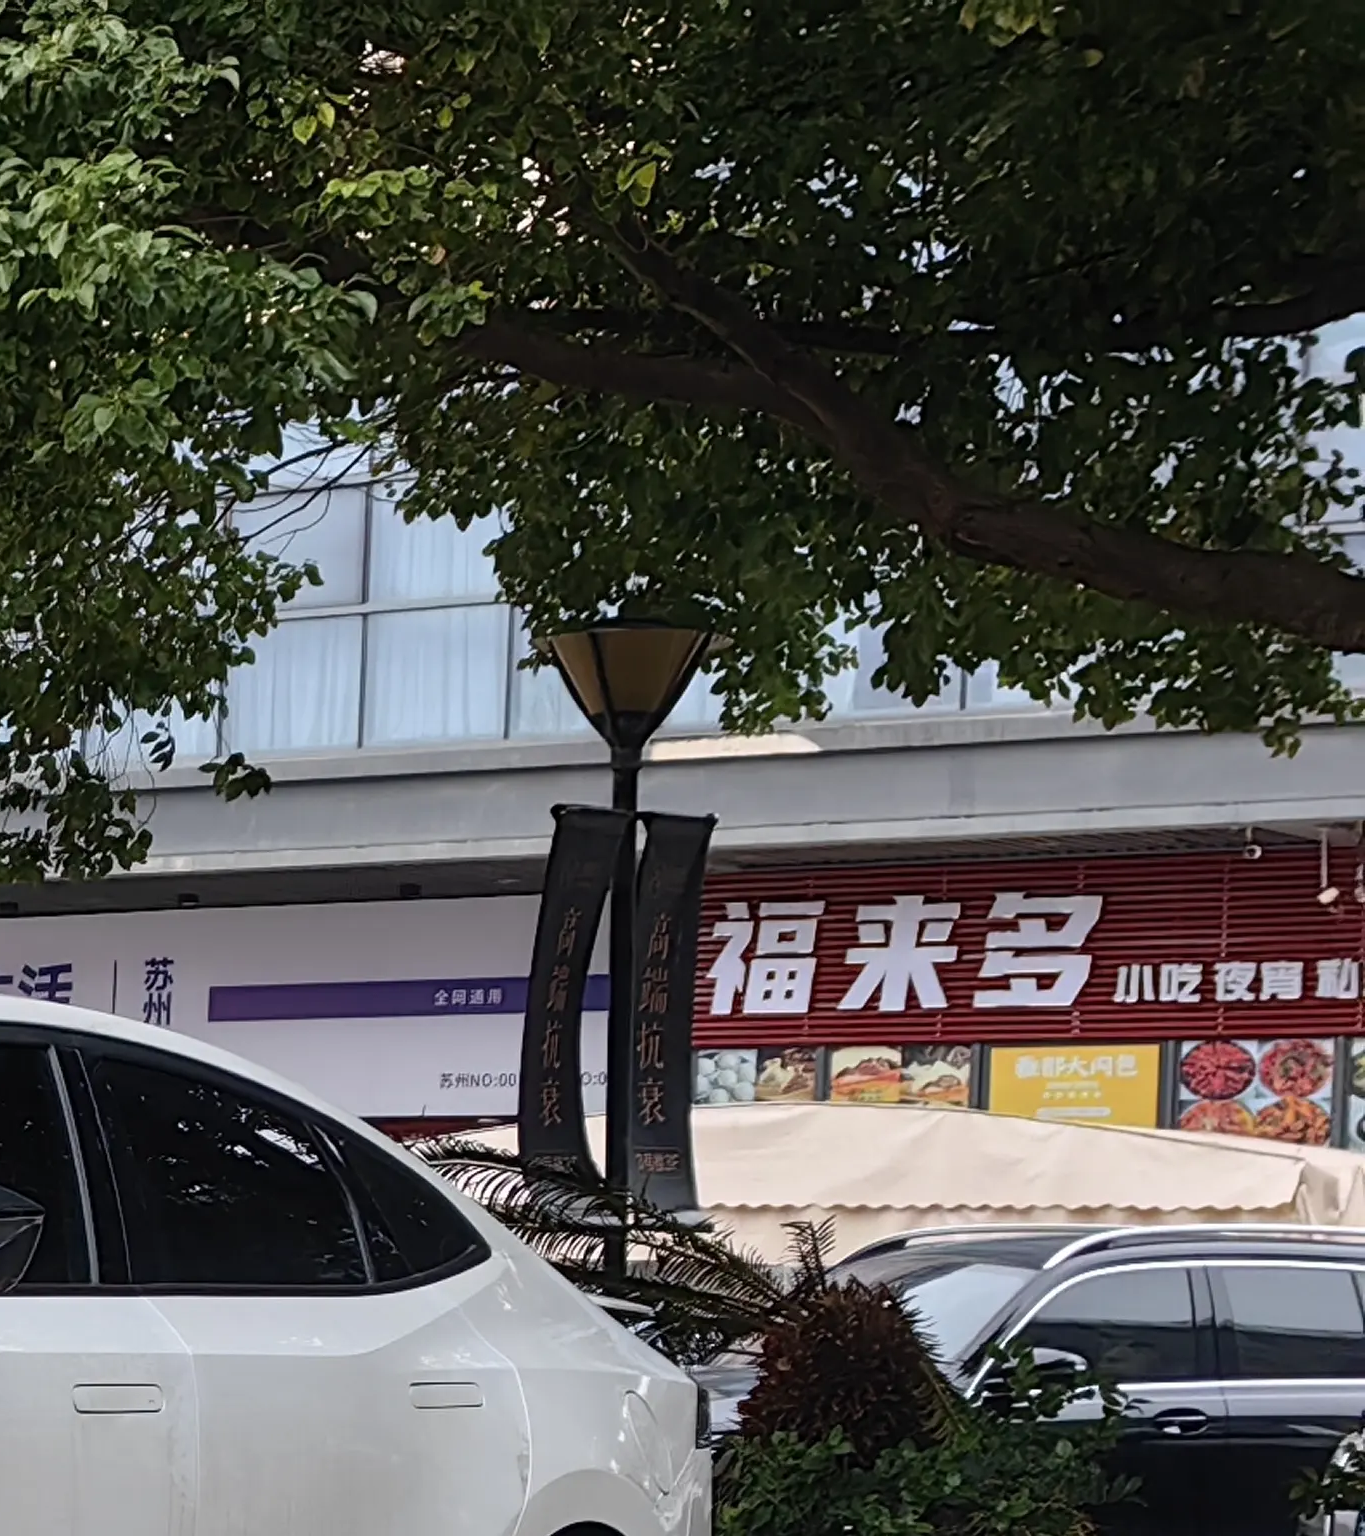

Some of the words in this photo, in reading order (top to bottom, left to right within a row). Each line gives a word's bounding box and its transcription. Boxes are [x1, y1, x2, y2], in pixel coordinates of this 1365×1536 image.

[142, 957, 175, 1026] 苏州
[706, 892, 1104, 1016] 福来多
[1113, 962, 1204, 1003] 小吃
[1214, 960, 1305, 1002] 夜宵
[537, 906, 583, 1128] 高端抗衰
[636, 911, 673, 1127] 高端抗衰
